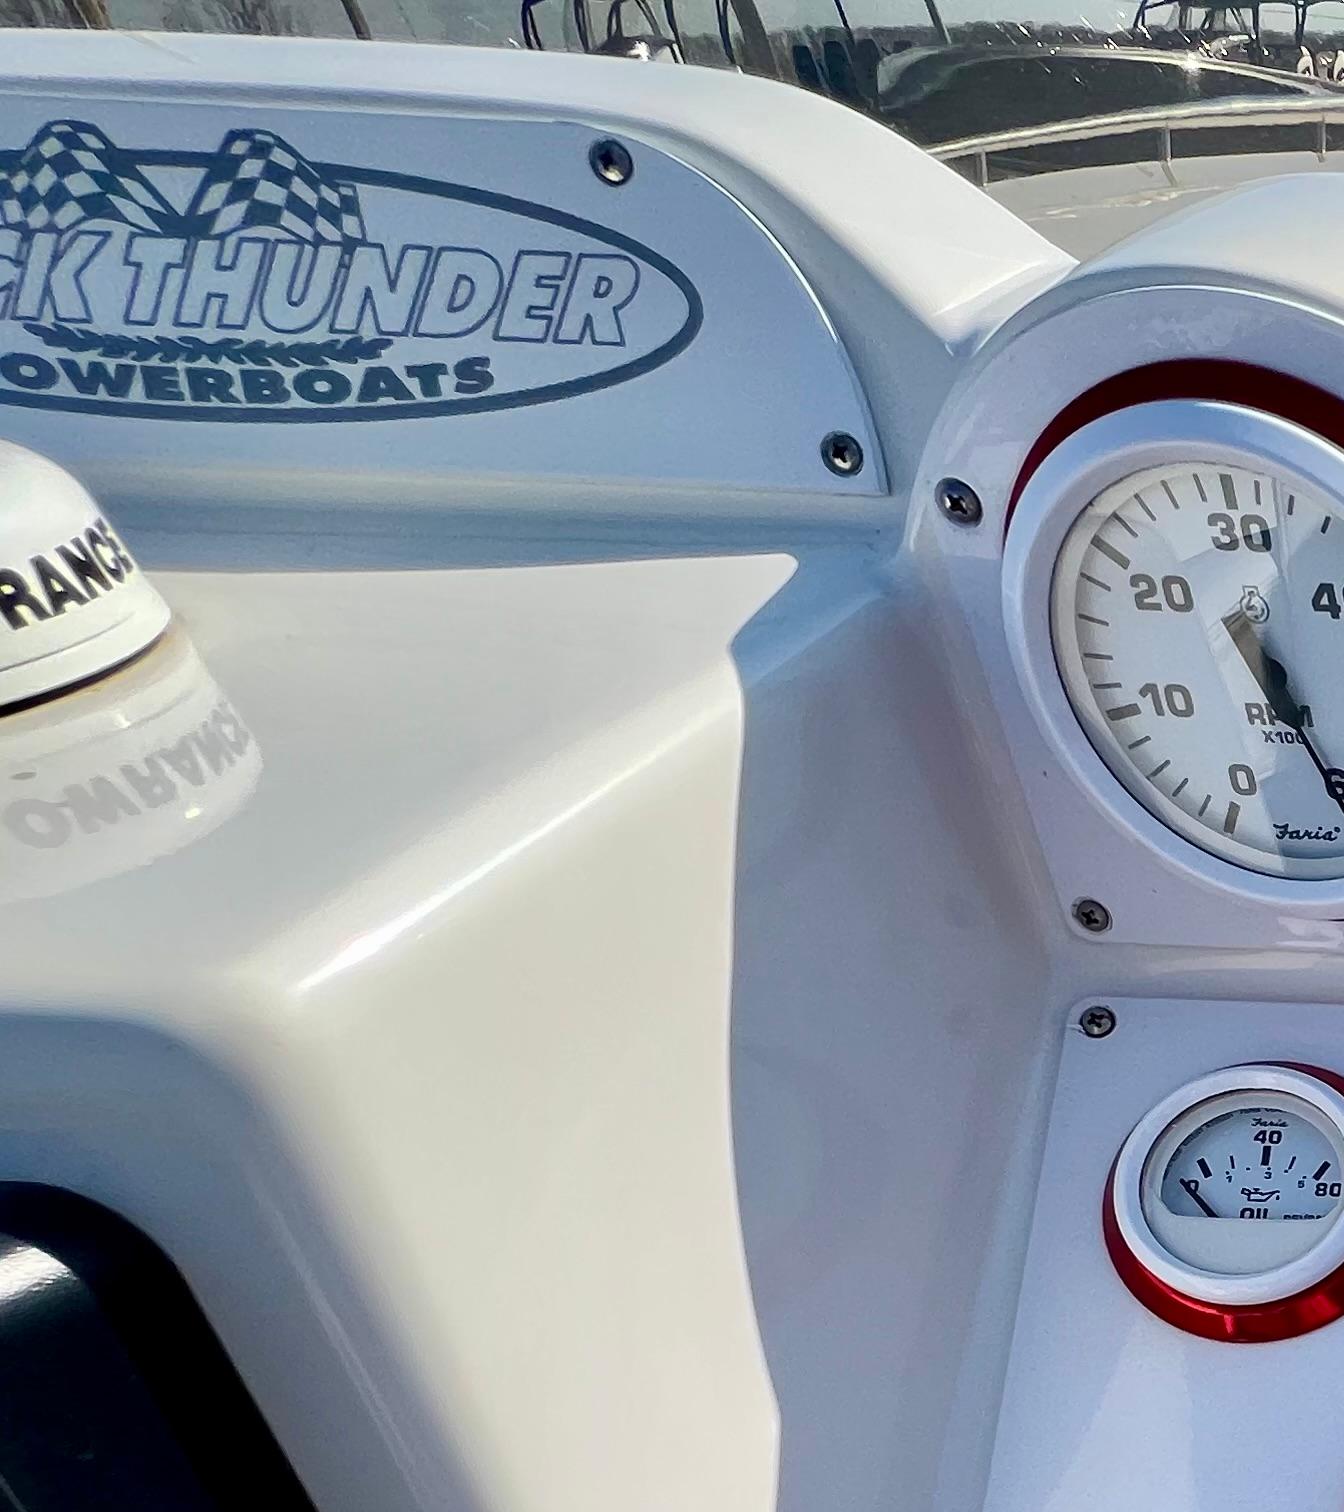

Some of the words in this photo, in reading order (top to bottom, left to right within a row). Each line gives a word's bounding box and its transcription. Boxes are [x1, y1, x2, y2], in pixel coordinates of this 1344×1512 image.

[123, 236, 642, 347] THUNDER
[1207, 513, 1272, 553] 30
[1130, 574, 1194, 612] 20
[1139, 683, 1194, 717] 10
[1229, 764, 1256, 795] 0
[1253, 1130, 1282, 1145] 40
[1264, 1171, 1272, 1180] 3
[1297, 1180, 1305, 1189] 5
[1315, 1182, 1342, 1197] 80
